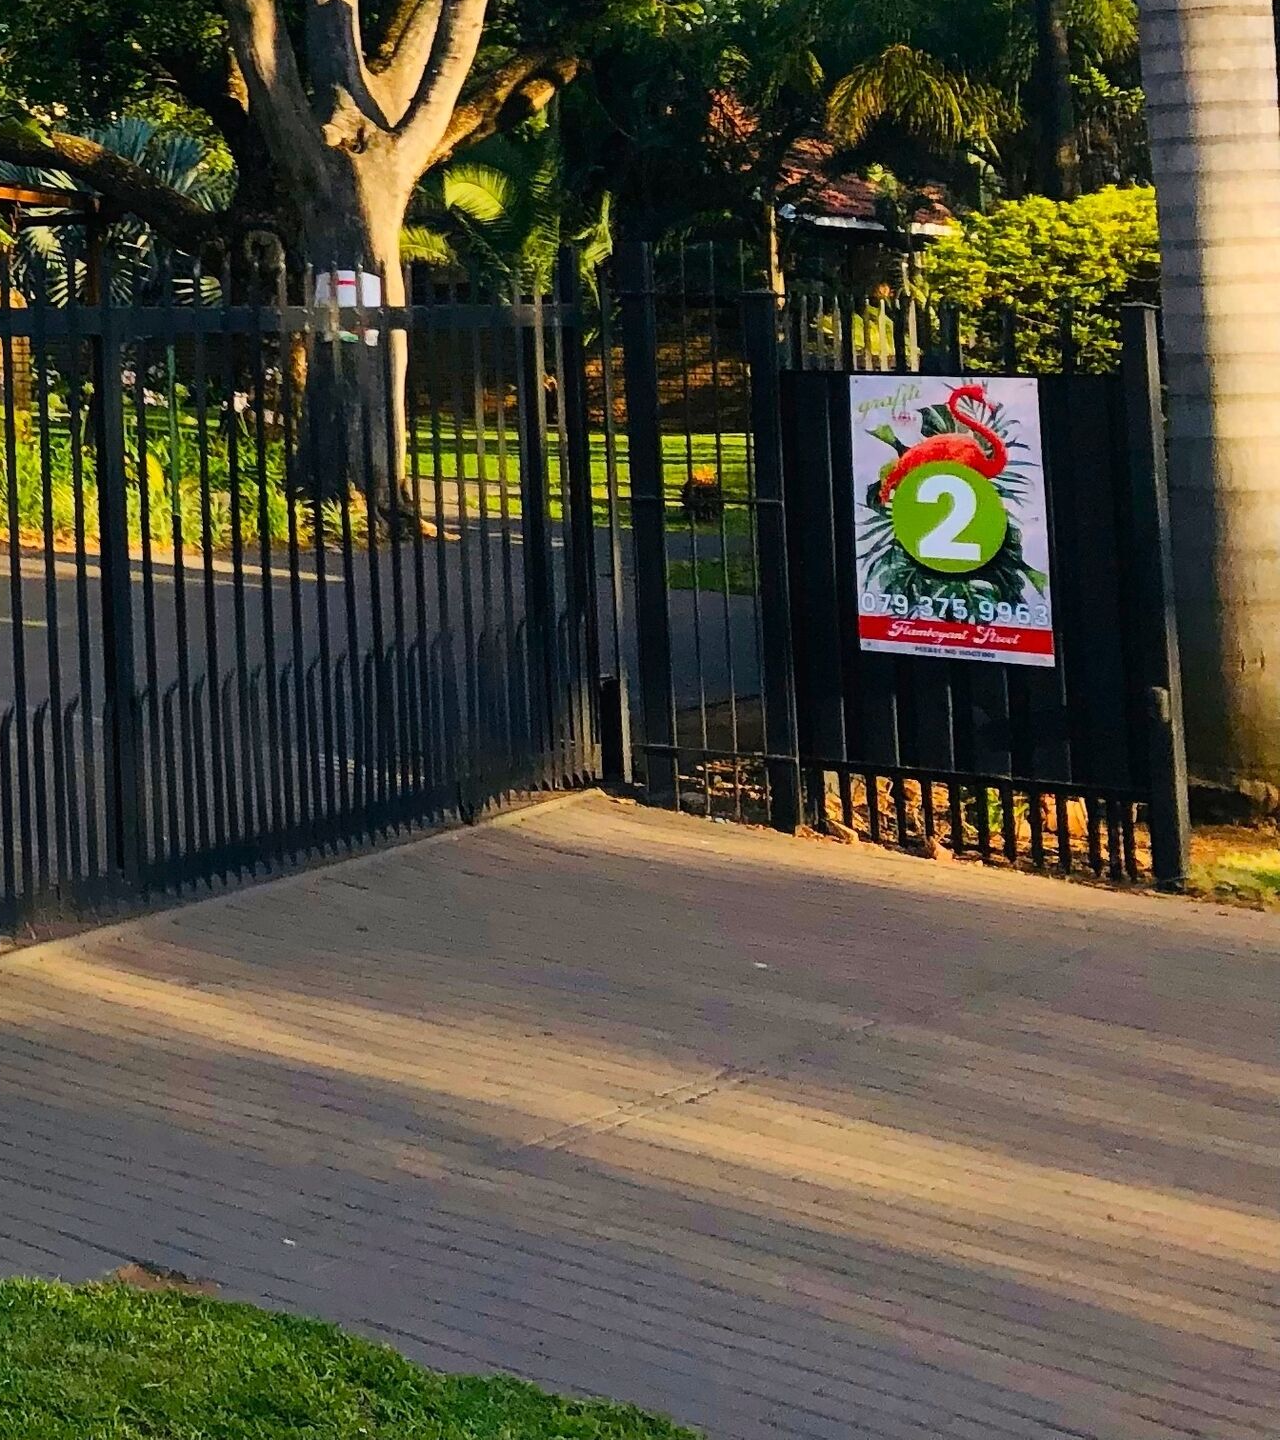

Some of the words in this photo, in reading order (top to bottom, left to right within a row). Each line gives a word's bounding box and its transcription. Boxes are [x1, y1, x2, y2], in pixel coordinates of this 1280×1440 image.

[916, 474, 981, 561] 2
[861, 593, 908, 616] 079
[919, 596, 968, 620] 375
[979, 600, 1049, 626] 9963
[973, 625, 1022, 645] Street
